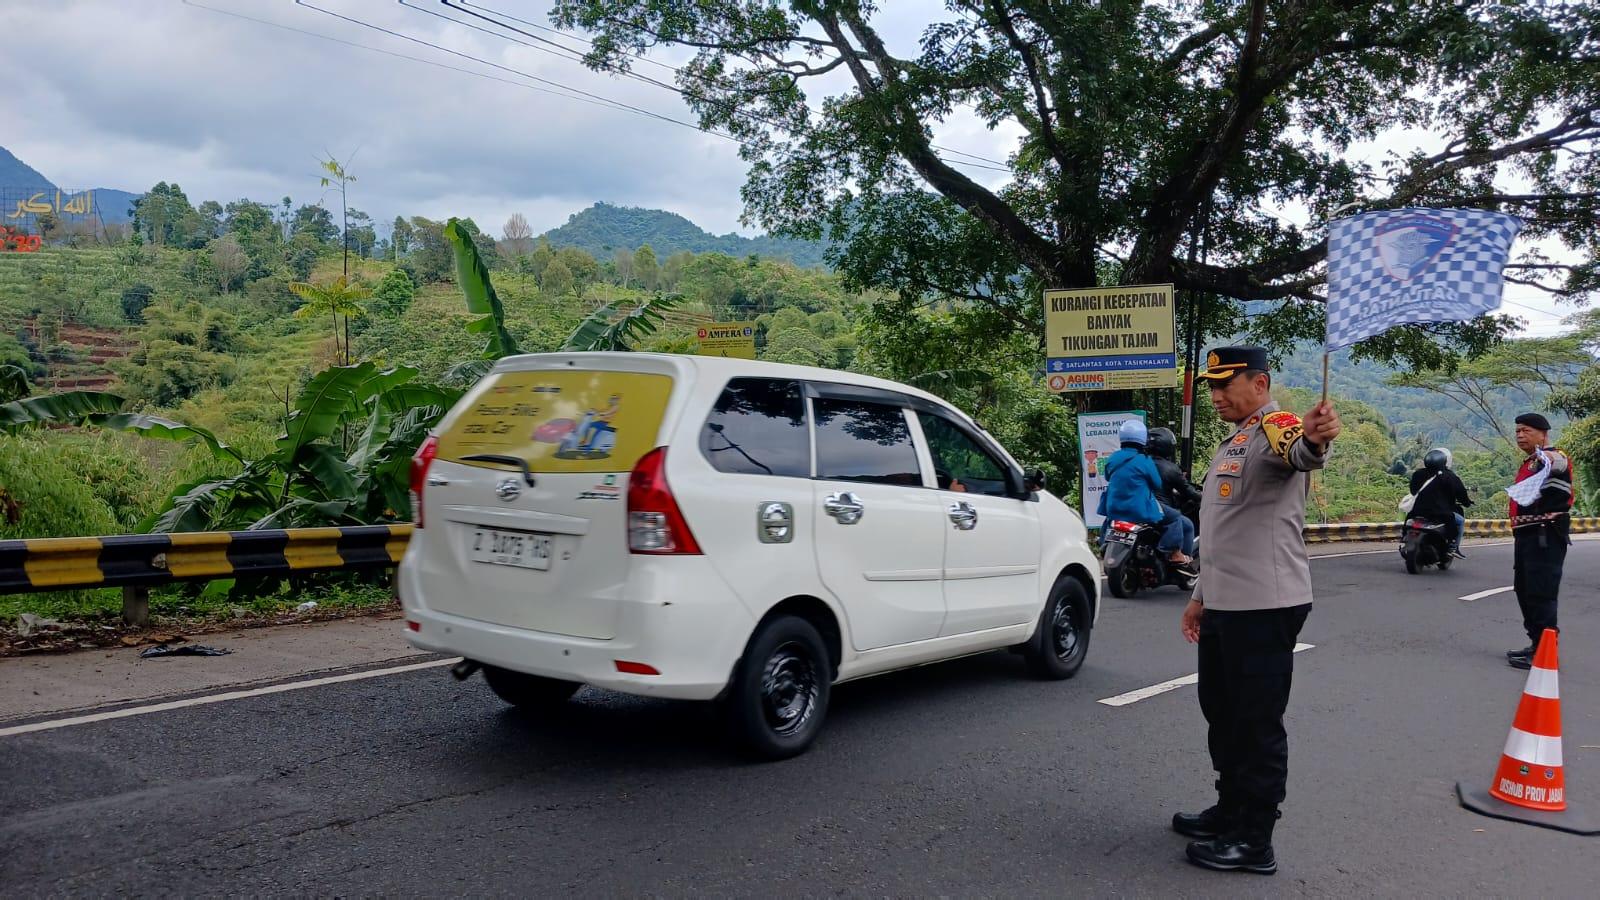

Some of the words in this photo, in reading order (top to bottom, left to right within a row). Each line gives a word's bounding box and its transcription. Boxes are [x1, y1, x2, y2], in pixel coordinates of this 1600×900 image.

[1051, 295, 1100, 312] KURANGI
[1104, 292, 1166, 310] KECEPATAN
[1087, 314, 1132, 330] BANYAK
[708, 330, 742, 338] AMPERA
[1061, 335, 1119, 352] TIKUNGAN
[1121, 332, 1158, 348] TAJAM
[1066, 361, 1102, 369] SATLANTAS
[1124, 358, 1169, 366] TASIKMALAYA
[1067, 374, 1104, 384] AGUNG
[1086, 429, 1117, 437] LEBARAN
[1225, 447, 1247, 456] POLRI
[1500, 777, 1524, 799] DISHUB
[1525, 785, 1546, 802] PROV
